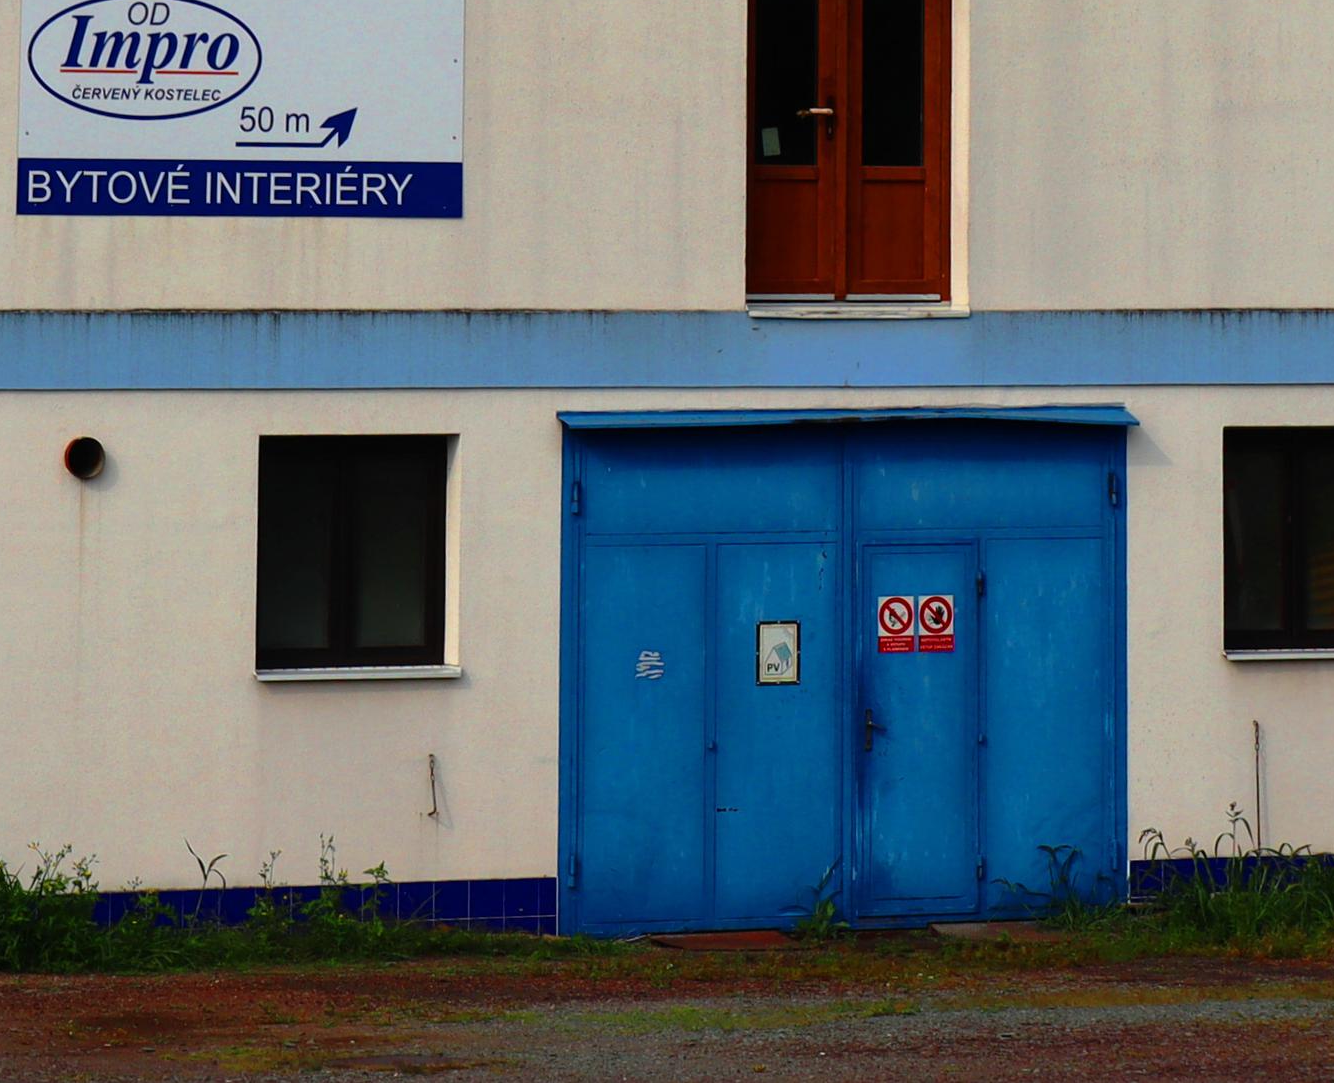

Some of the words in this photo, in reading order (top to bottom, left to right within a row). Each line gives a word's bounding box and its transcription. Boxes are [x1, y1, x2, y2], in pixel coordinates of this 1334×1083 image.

[127, 1, 171, 26] OD
[61, 15, 240, 84] Impro
[71, 84, 141, 101] ČERVENÝ
[144, 89, 221, 102] KOSTELEC
[239, 106, 274, 133] 50
[284, 111, 310, 133] m
[27, 165, 191, 205] BYTOVÉ
[205, 166, 413, 206] INTERIÉRY
[767, 663, 780, 672] PV
